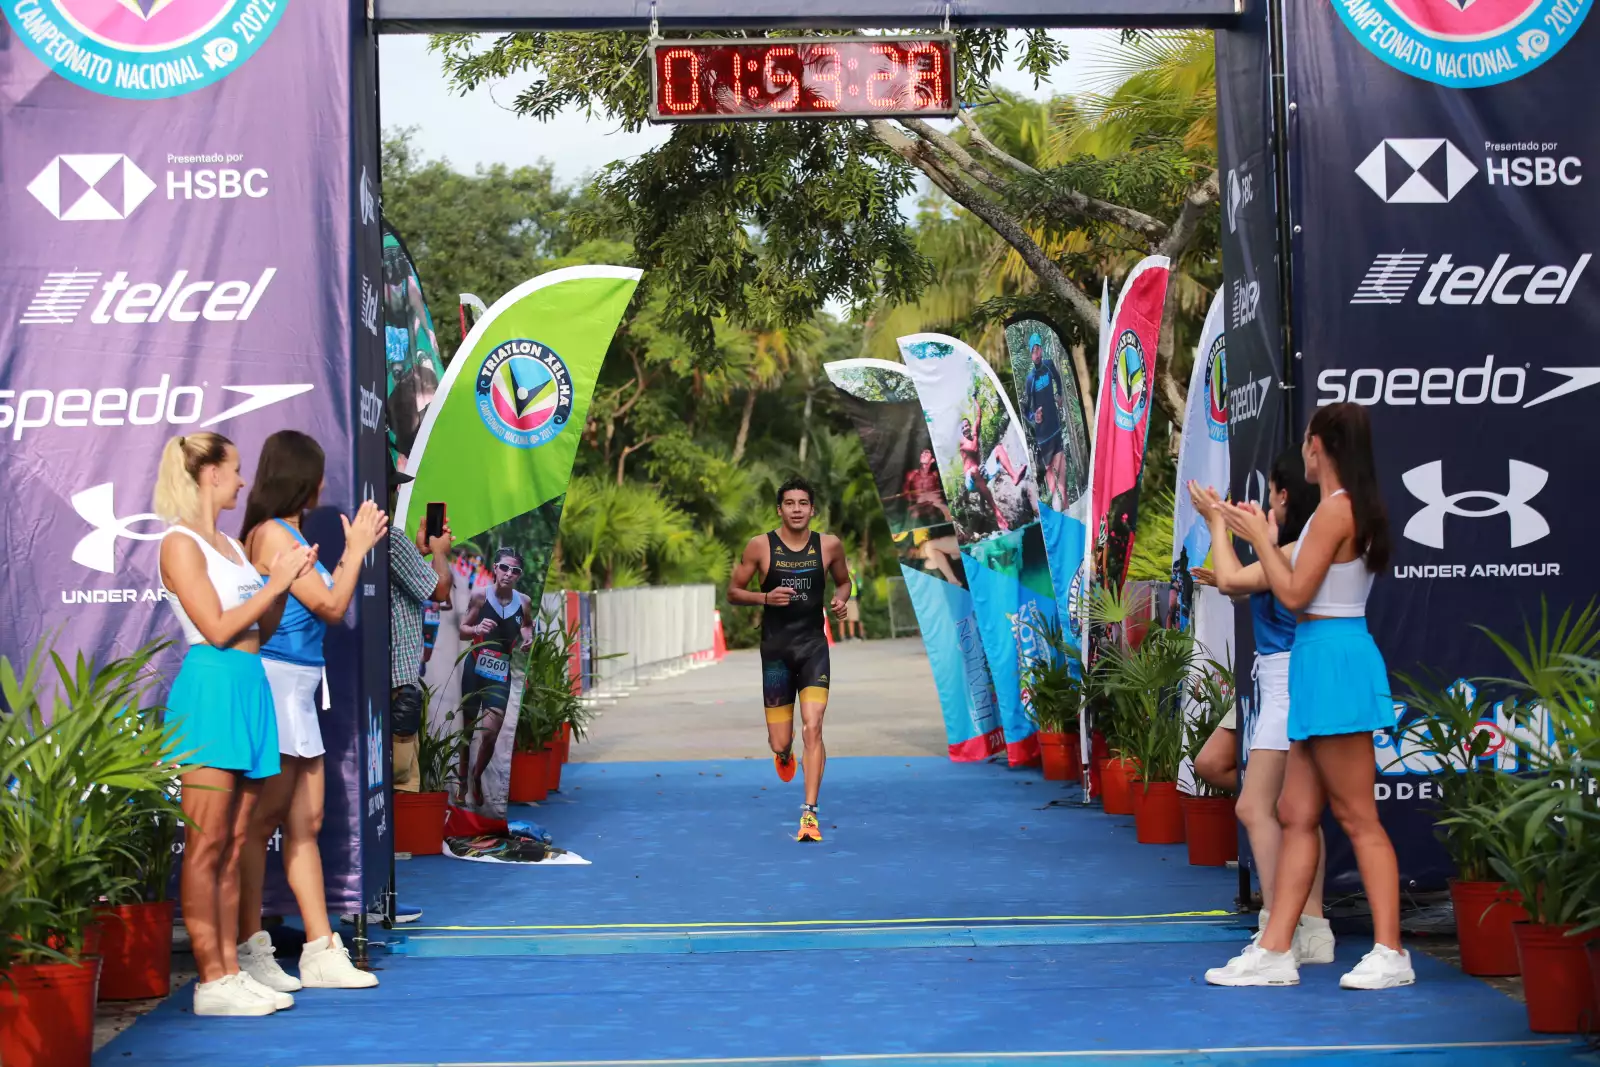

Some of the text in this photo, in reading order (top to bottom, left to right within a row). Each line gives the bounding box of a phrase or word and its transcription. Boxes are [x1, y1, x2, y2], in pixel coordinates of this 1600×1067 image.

[14, 0, 112, 84] CAMPEONATO
[115, 55, 204, 90] NACIONAL
[1341, 0, 1583, 79] AMPEONATO NACIONAL 202
[664, 45, 942, 111] 01:53:28
[167, 152, 244, 165] Presentado por
[1485, 140, 1558, 153] Presentado por
[166, 168, 269, 200] HSBC
[1486, 156, 1583, 187] HSBC
[90, 267, 278, 324] telcel
[1417, 254, 1593, 305] telcel
[1316, 355, 1527, 406] speedo
[0, 374, 204, 440] speedo
[775, 560, 817, 568] ASDEPORTE
[1394, 563, 1561, 579] UNDER ARMOUR
[62, 588, 138, 604] UNDER
[480, 656, 507, 672] 0560
